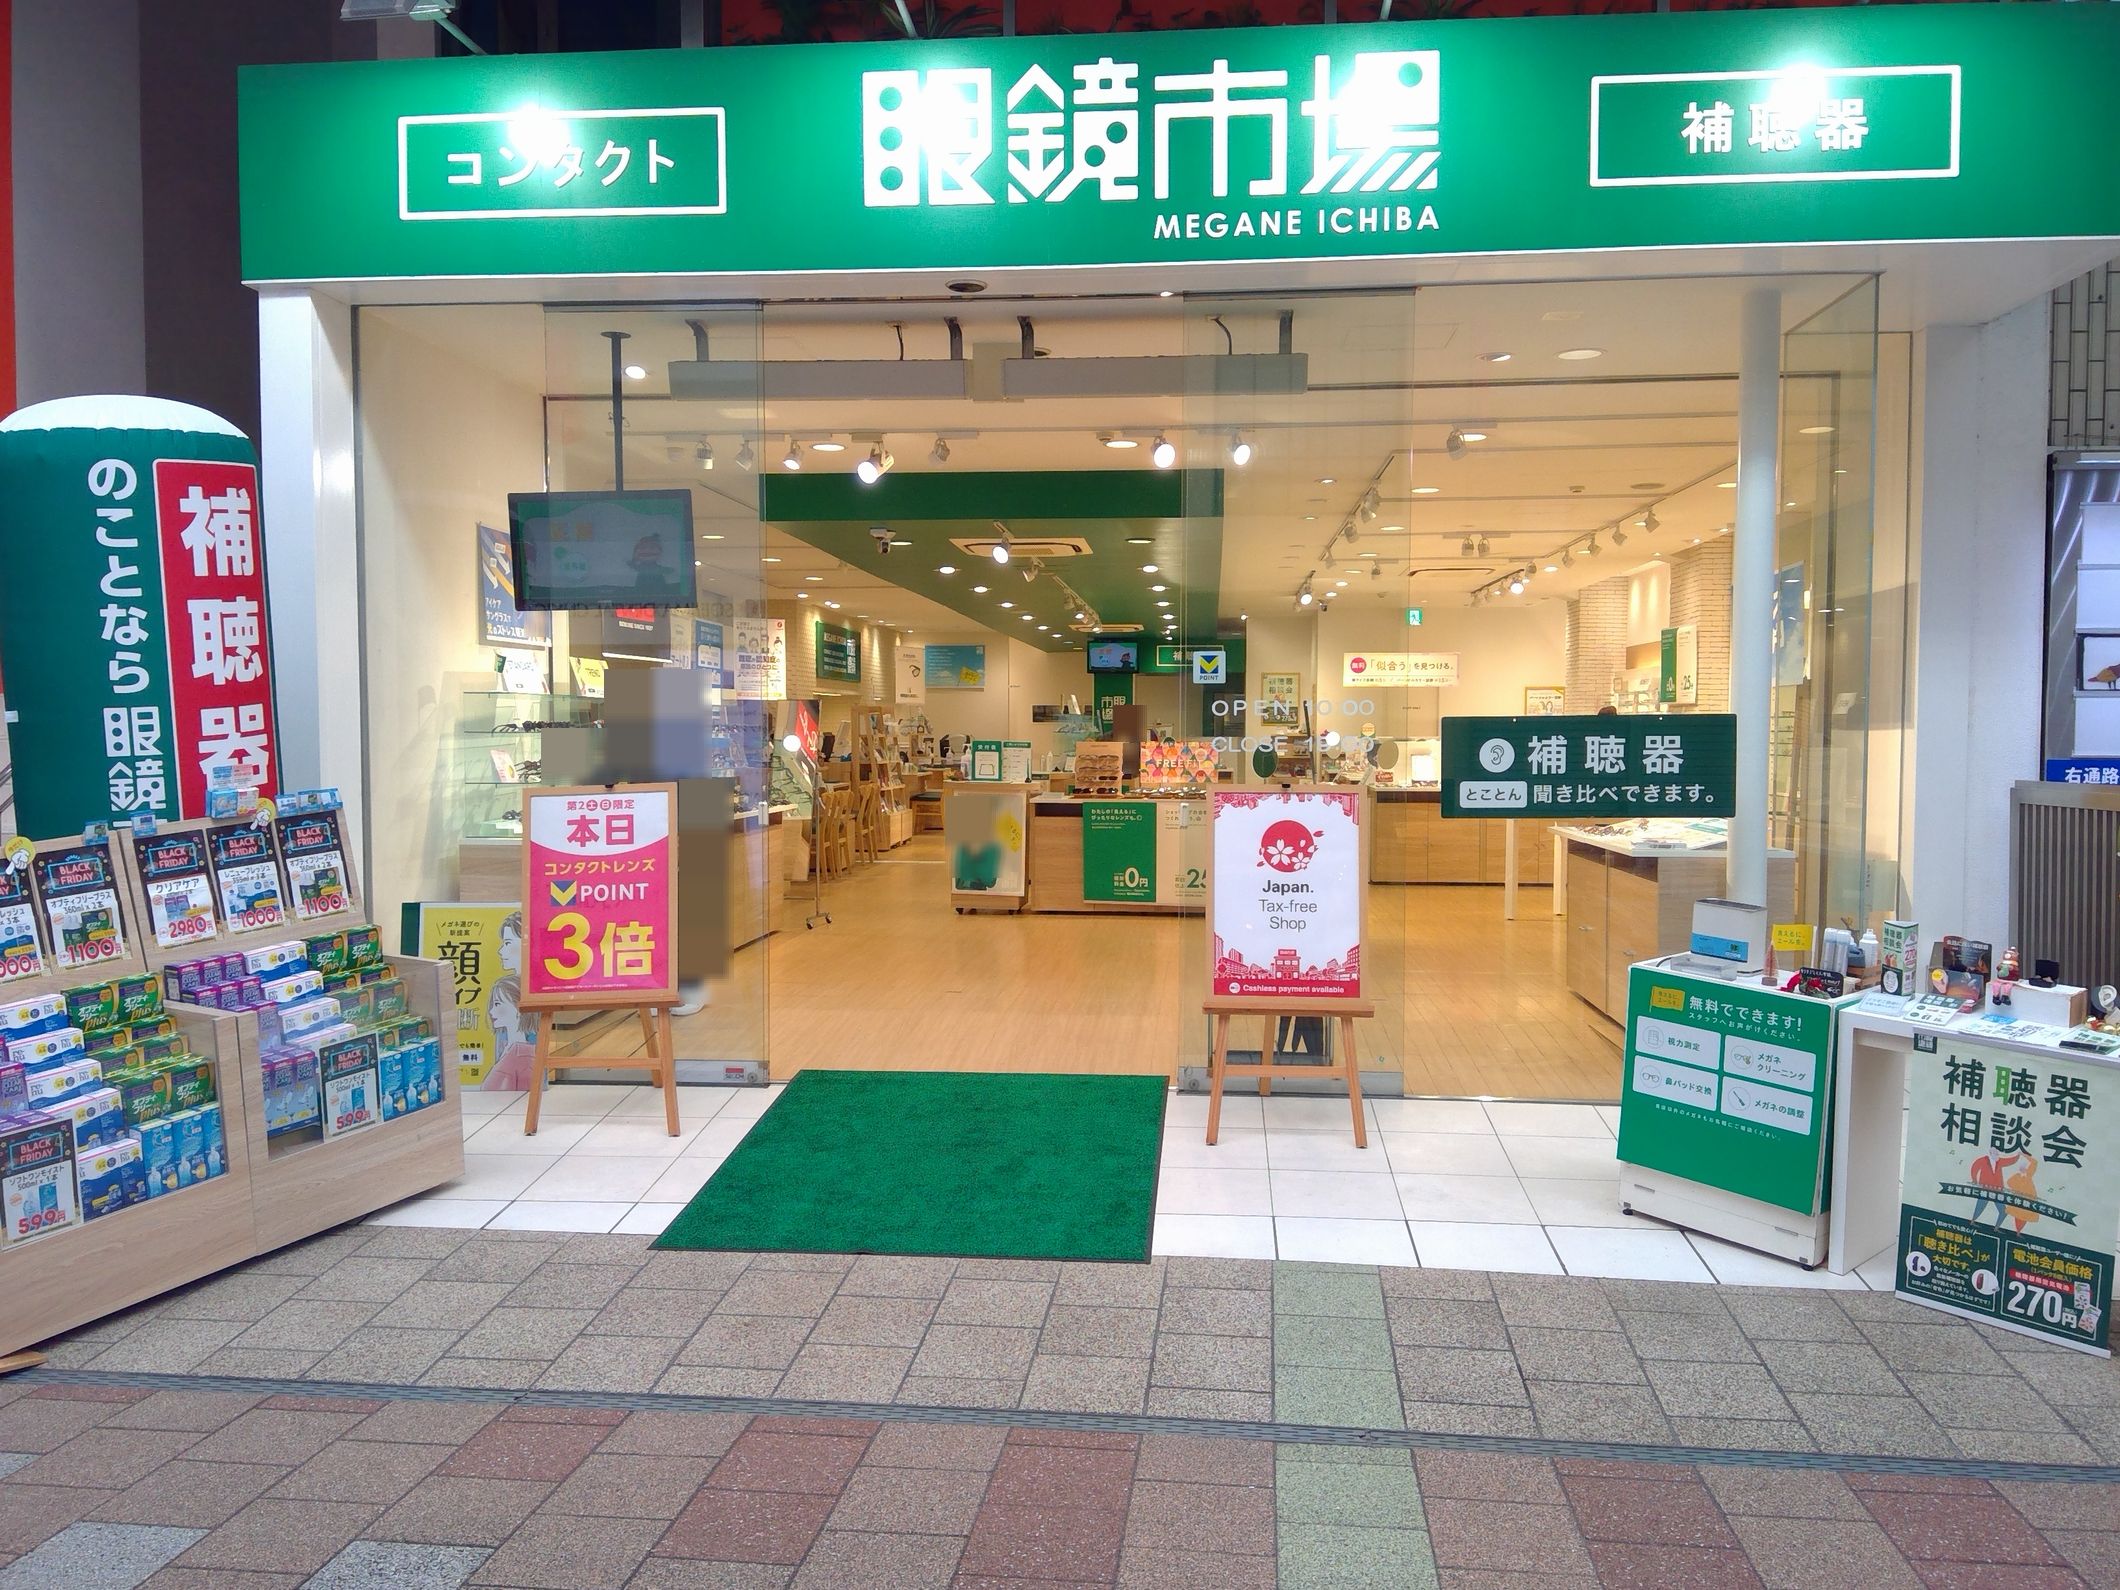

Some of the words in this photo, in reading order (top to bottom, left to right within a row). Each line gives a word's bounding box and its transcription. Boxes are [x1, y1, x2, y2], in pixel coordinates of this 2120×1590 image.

[862, 50, 1441, 207] 眼鏡市場
[1680, 98, 1869, 154] 補聴器
[447, 139, 675, 187] コンタクト
[1153, 210, 1302, 240] MEGANE
[1318, 206, 1440, 235] ICHIBA
[88, 458, 169, 826] のことなら眼鏡
[179, 486, 270, 786] 補聴器
[1211, 699, 1291, 717] OPEN
[1211, 736, 1289, 753] CLOSE
[1156, 759, 1184, 768] FREE
[1527, 734, 1684, 775] 補聴器
[2064, 766, 2120, 785] 右通路
[1466, 787, 1522, 801] とことん
[1532, 784, 1715, 804] 聞き比べできます。
[296, 826, 322, 838] BLACK
[566, 814, 635, 847] 本日
[228, 837, 256, 848] BLACK
[297, 836, 324, 846] FRIDAY
[158, 848, 187, 859] BLACK
[229, 846, 258, 858] FRIDAY
[59, 862, 91, 875] BLACK
[159, 857, 189, 869] FRIDAY
[544, 858, 657, 876] コンタクトレンズ
[60, 871, 94, 885] FRIDAY
[156, 878, 200, 894] クリアケア
[1125, 867, 1149, 888] 0円
[580, 882, 650, 902] POINT
[1262, 880, 1315, 896] Japan.
[50, 891, 112, 907] オプティフリープラス
[91, 901, 104, 910] 2本
[305, 894, 348, 915] 1100円
[1258, 899, 1318, 913] Tax-free
[1269, 916, 1307, 933] Shop
[67, 937, 122, 963] 1100円
[543, 911, 656, 981] 3倍
[437, 940, 482, 985] 顔
[455, 986, 482, 1006] イプ
[1242, 984, 1277, 992] Cashless
[1278, 985, 1310, 994] payment
[1311, 984, 1345, 993] available
[124, 994, 149, 1006] オプティ
[125, 1003, 144, 1013] フリー
[77, 1004, 105, 1016] オプティ
[79, 1012, 100, 1023] フリー
[457, 1007, 480, 1031] 断
[1688, 995, 1802, 1031] 無料でできます!
[1688, 1012, 1802, 1042] スタッフへお声がけください。
[1667, 1036, 1701, 1052] 視力測定
[337, 1058, 363, 1070] FRIDAY
[338, 1050, 362, 1061] BLACK
[462, 1053, 479, 1062] 無料
[1757, 1053, 1782, 1064] メガネ
[1757, 1063, 1807, 1082] クリーニング
[1665, 1077, 1713, 1096] 鼻パッド交換
[1942, 1054, 2092, 1120] 補聴器
[1754, 1100, 1806, 1120] メガネの調整
[1940, 1102, 2088, 1169] 相談会
[20, 1138, 52, 1155] BLACK
[20, 1149, 54, 1164] FRIDAY
[9, 1166, 65, 1186] ソフトワンモイスト
[17, 1180, 38, 1191] 500ml
[18, 1208, 66, 1235] 599円
[2012, 1247, 2094, 1281] 電池会員価格
[2007, 1280, 2078, 1329] 270円
